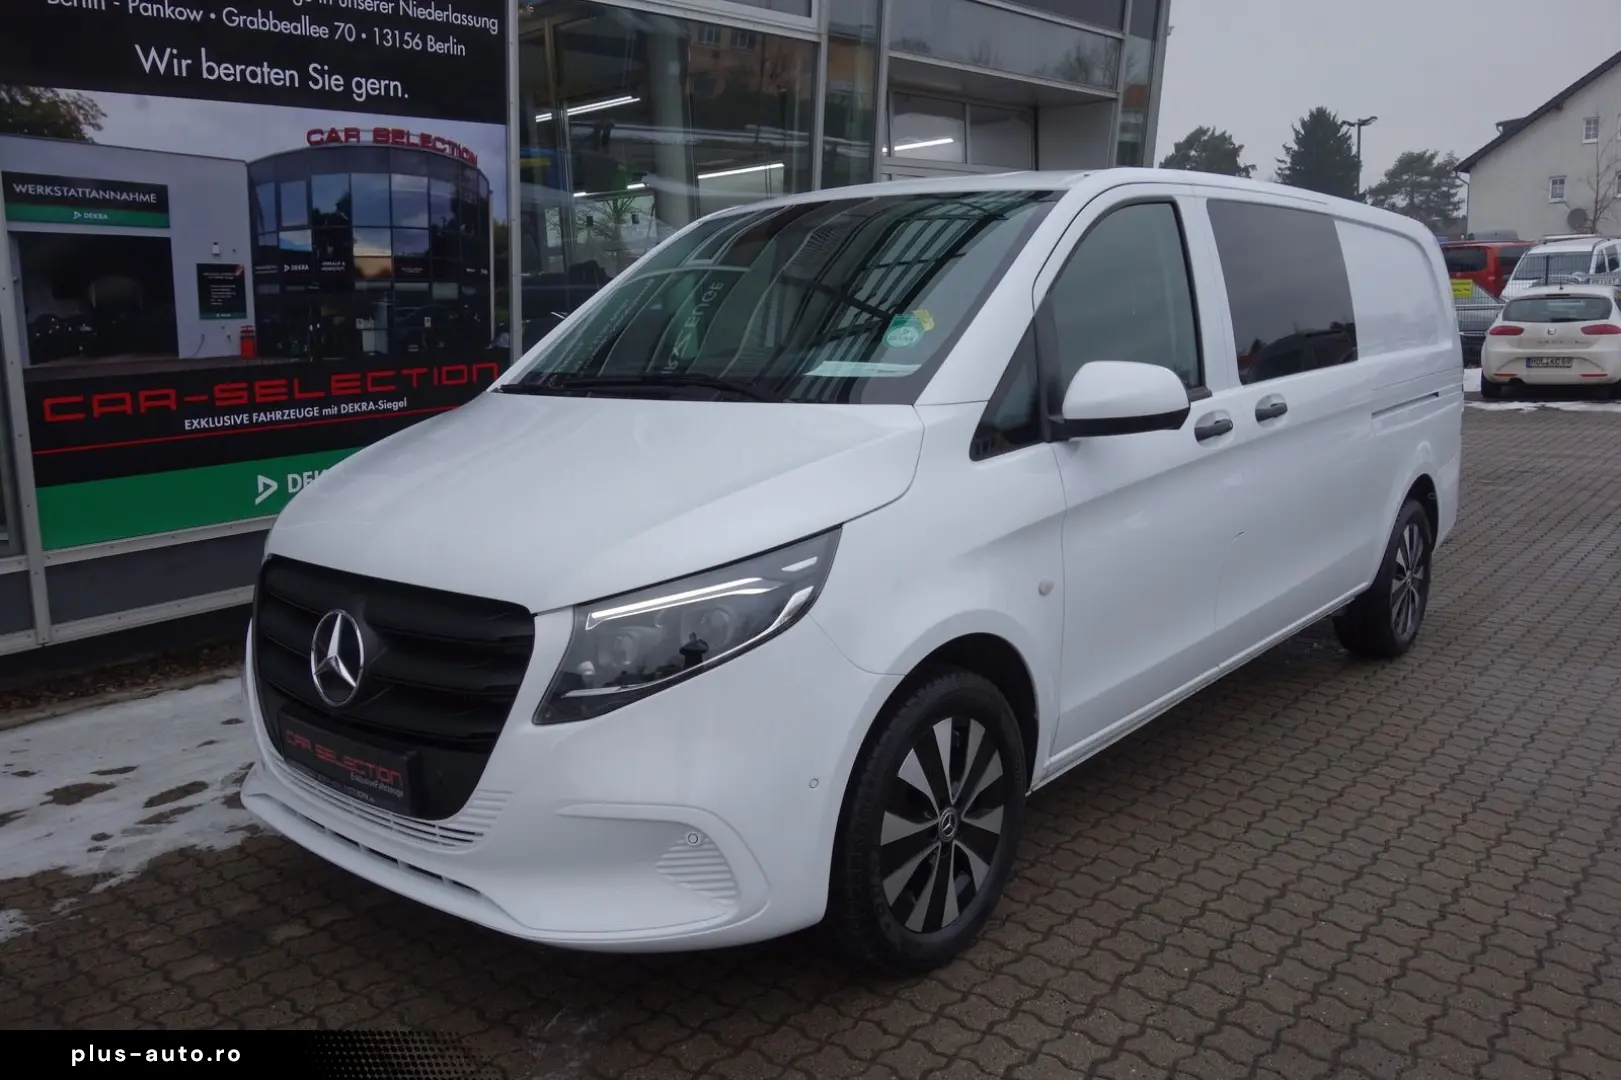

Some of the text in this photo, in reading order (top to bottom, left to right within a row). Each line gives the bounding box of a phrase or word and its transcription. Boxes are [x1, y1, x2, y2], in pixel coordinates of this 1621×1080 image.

[47, 0, 106, 10] erlin
[128, 0, 203, 21] Pankow
[222, 7, 329, 39] Grabbeallee
[333, 21, 356, 42] 70
[373, 27, 423, 51] 13156
[427, 35, 466, 56] Berlin
[339, 0, 499, 35] unserer Niederlassung
[135, 43, 409, 102] Wir beraten Sie gern.
[306, 127, 478, 167] CAR SELECTION
[12, 183, 157, 204] WERKSTATTANNAHME
[184, 397, 408, 431] EXKLUSIVE FAHRZEUGE mit DEKRA-Siegel
